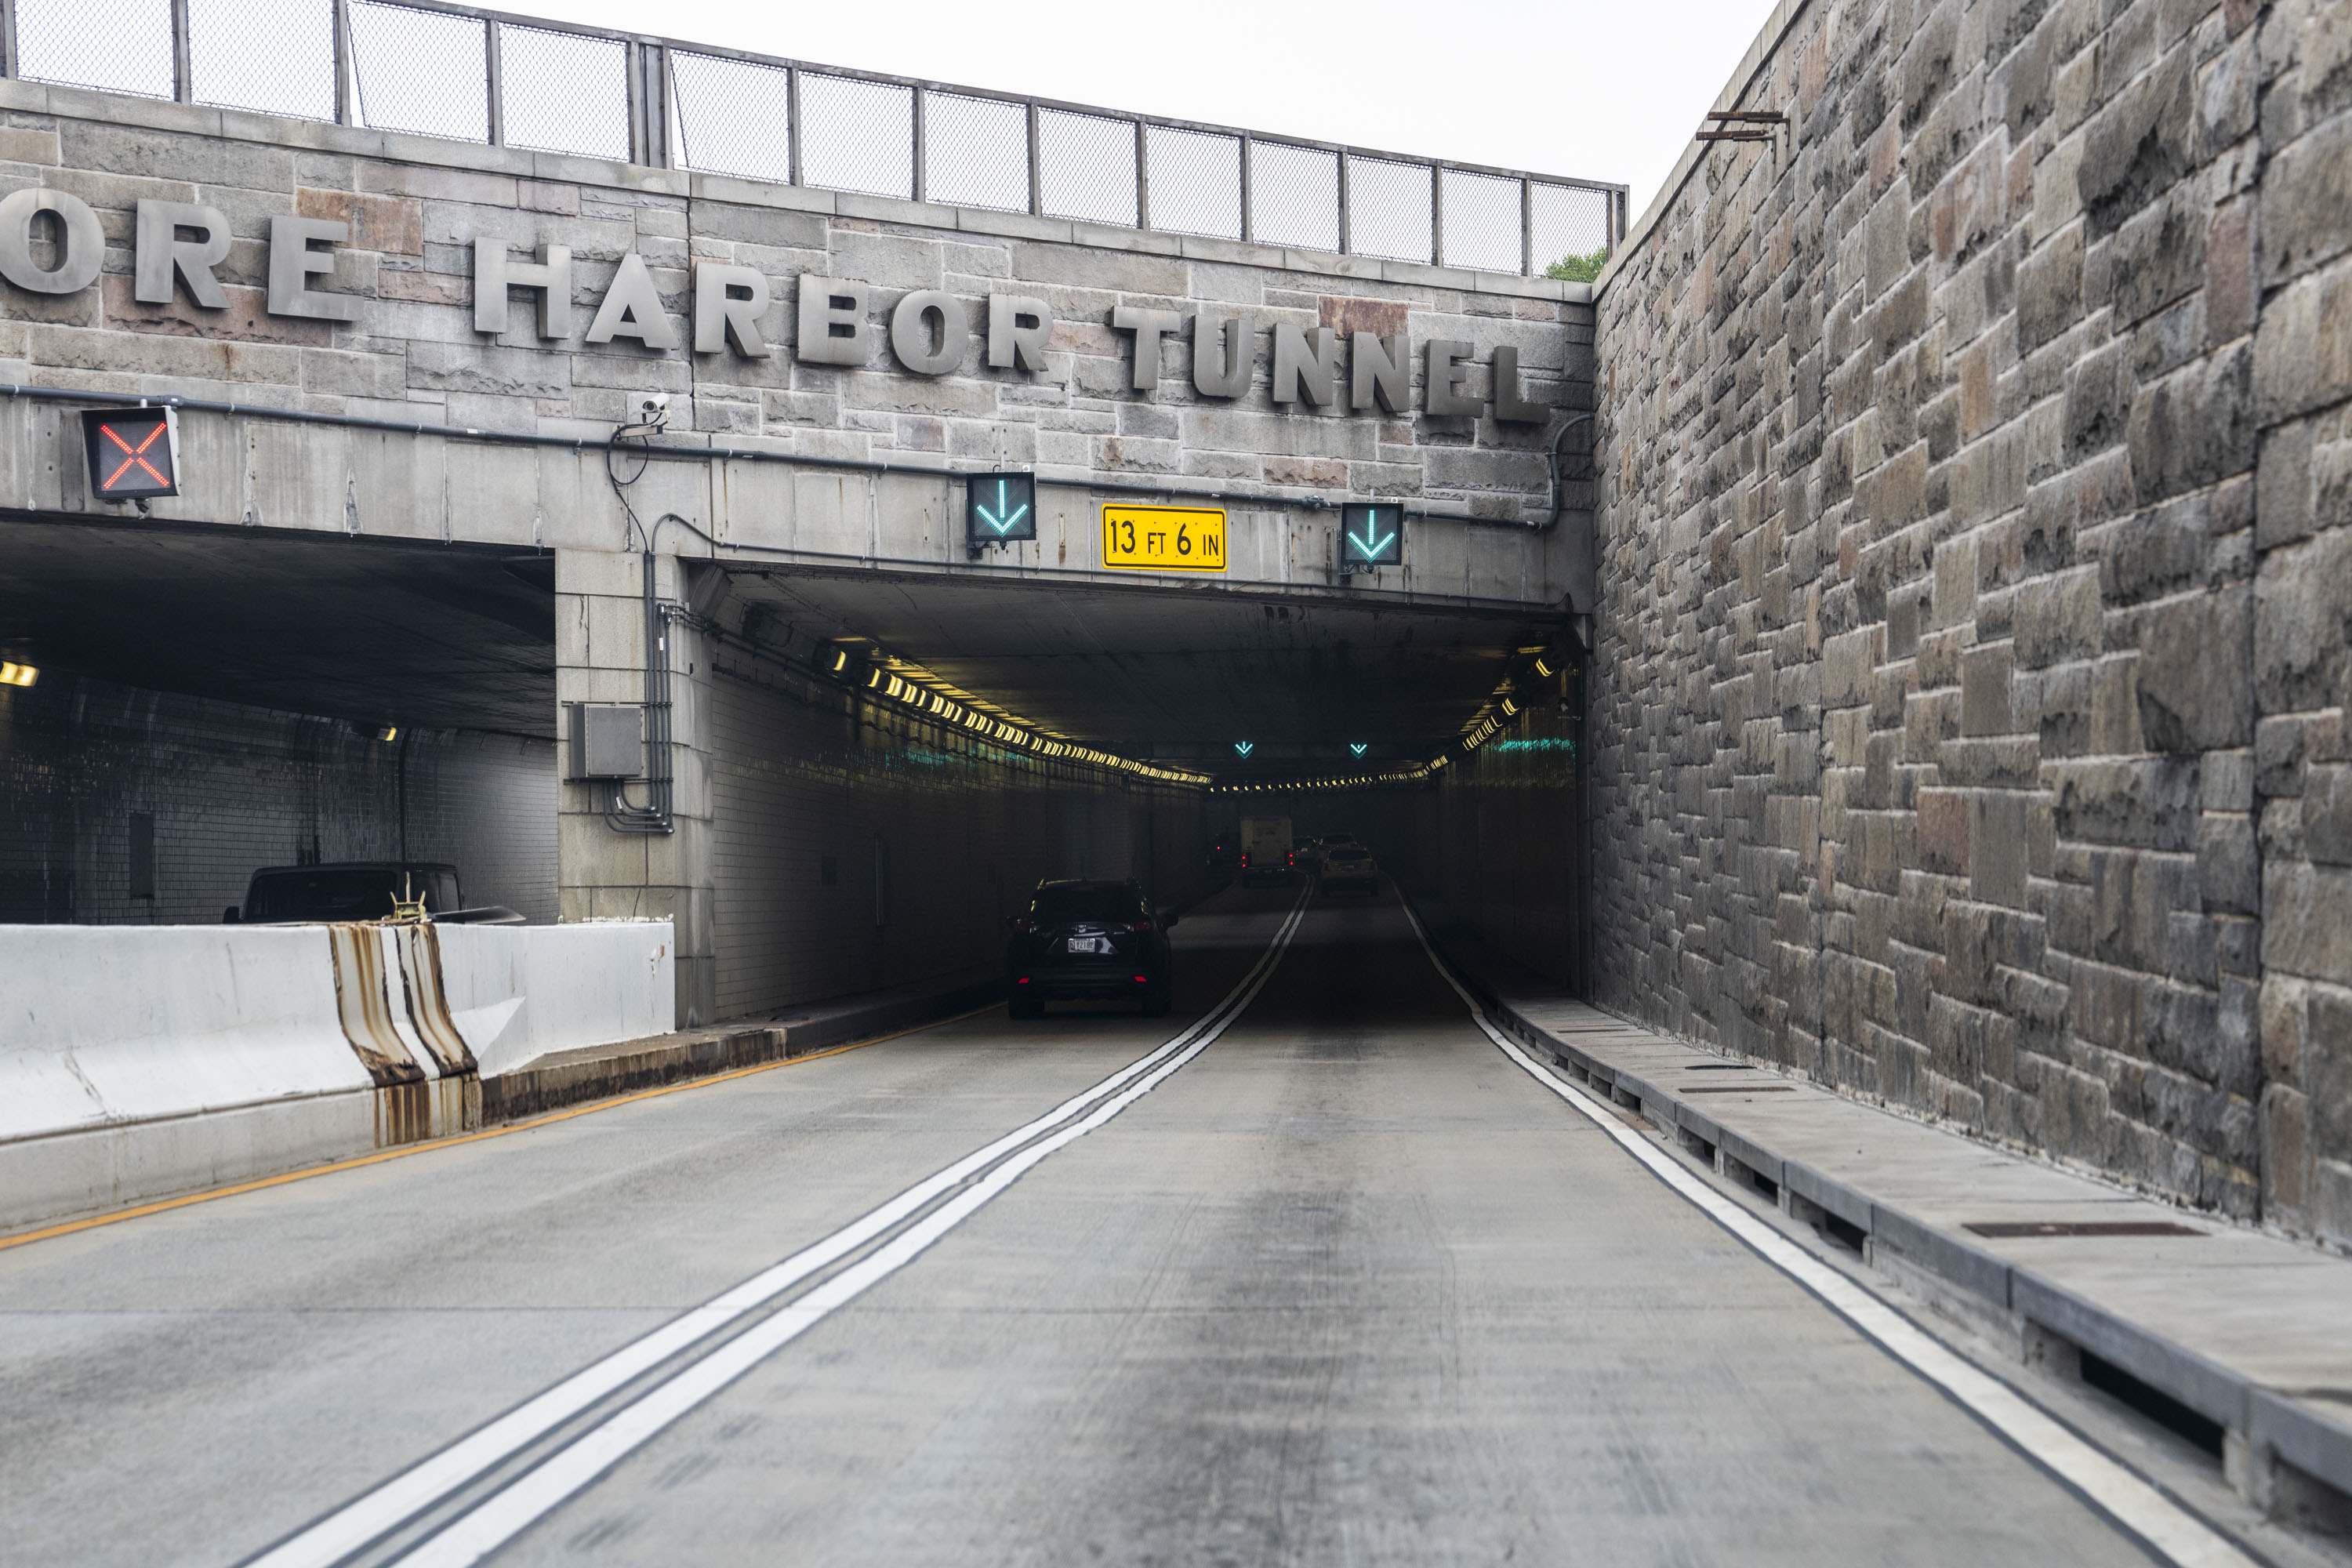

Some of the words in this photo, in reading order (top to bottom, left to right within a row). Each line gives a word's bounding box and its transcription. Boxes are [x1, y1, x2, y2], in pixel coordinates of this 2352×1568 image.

[473, 237, 1052, 375] HARBOR
[1112, 306, 1550, 423] TUNNEL
[1111, 520, 1135, 554] 13
[1148, 532, 1166, 554] FT
[1177, 523, 1191, 555] 6
[1203, 534, 1218, 556] IN
